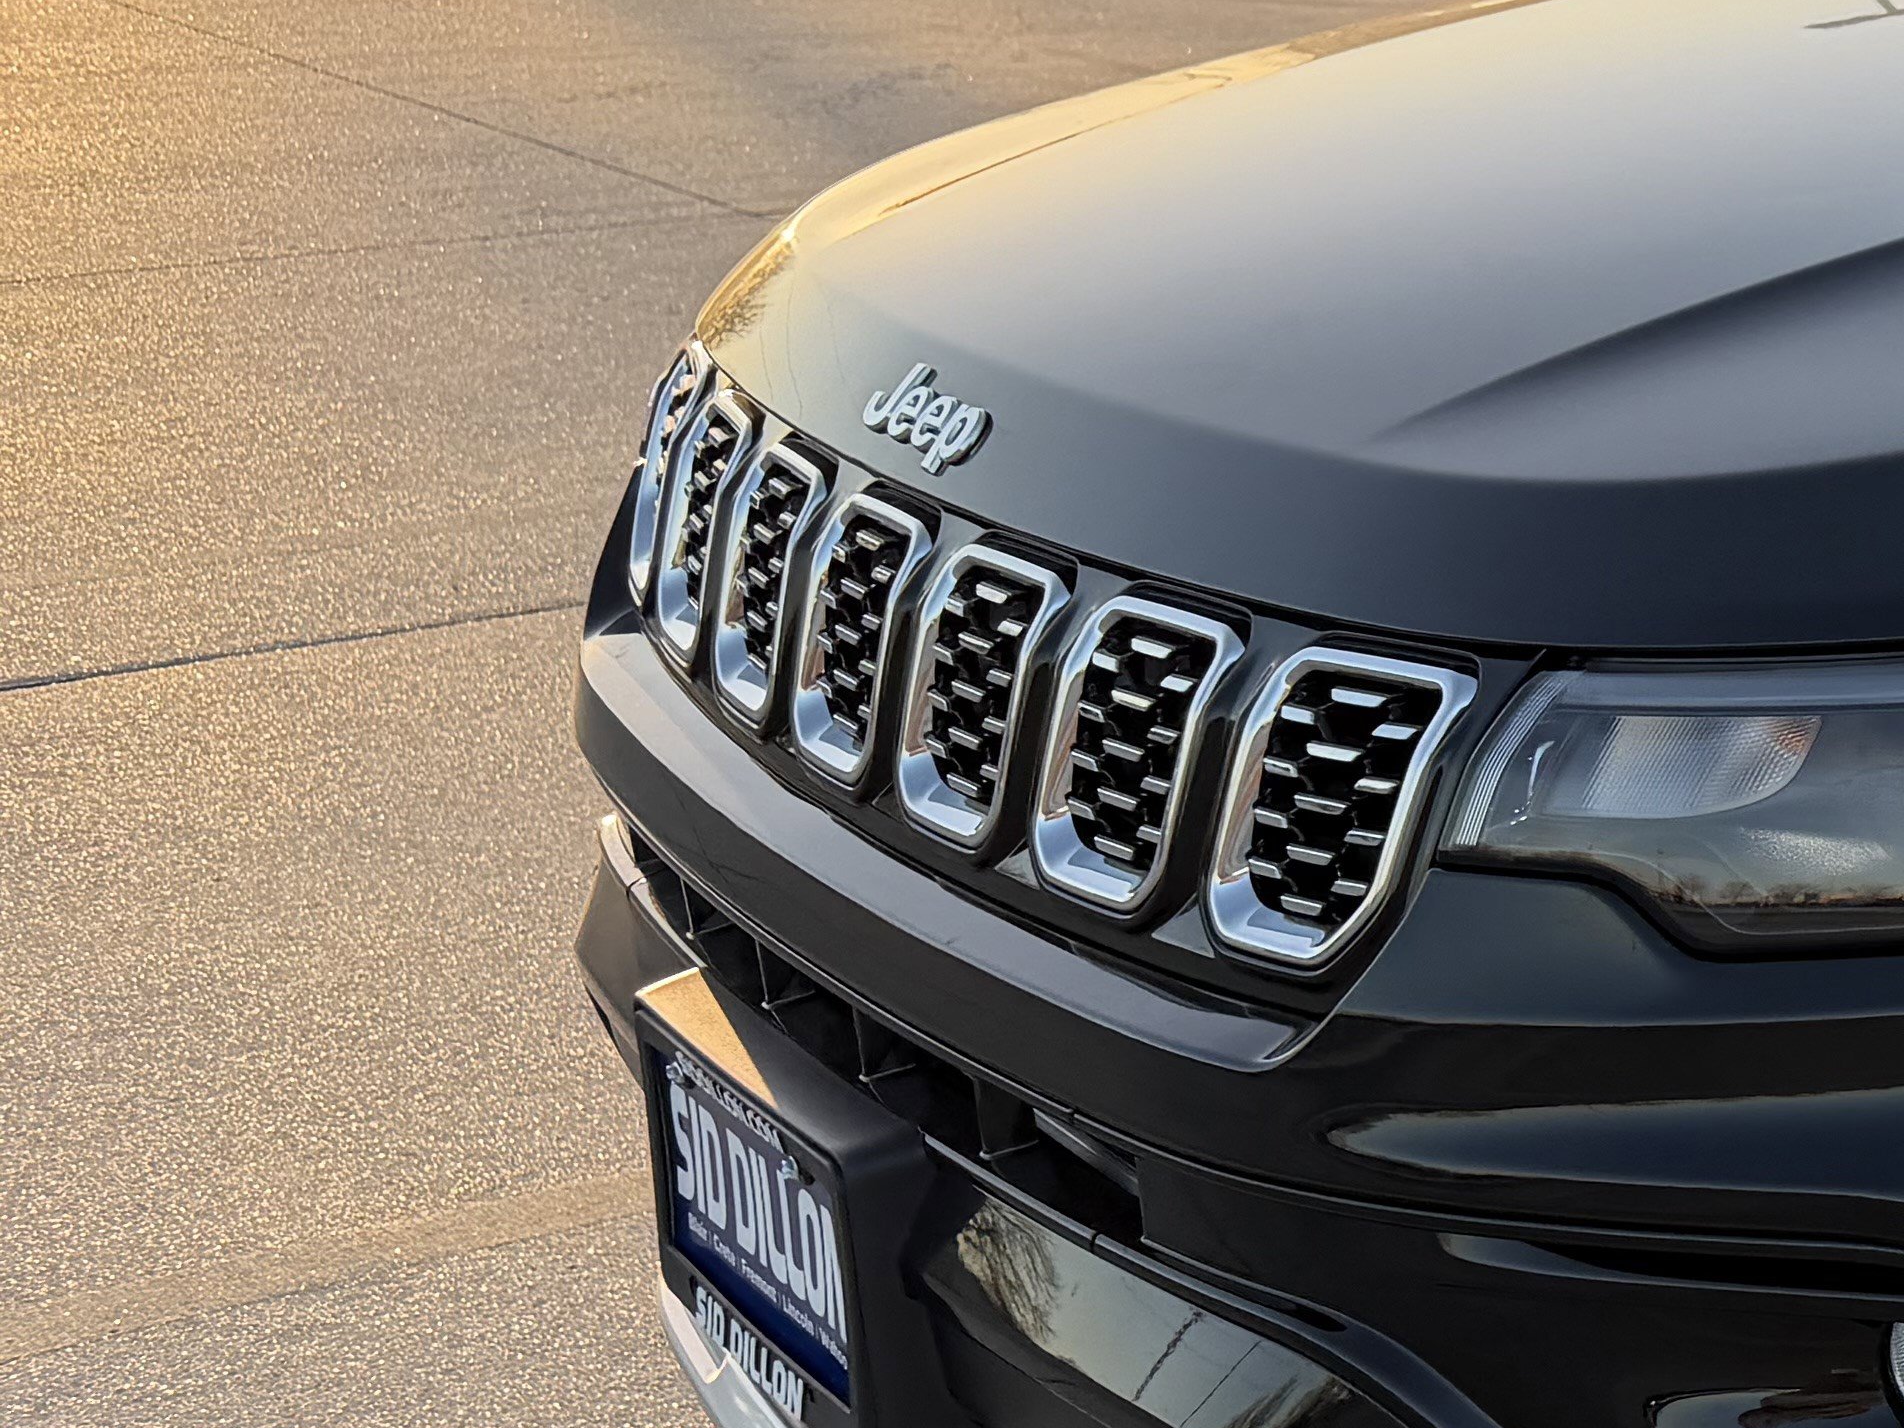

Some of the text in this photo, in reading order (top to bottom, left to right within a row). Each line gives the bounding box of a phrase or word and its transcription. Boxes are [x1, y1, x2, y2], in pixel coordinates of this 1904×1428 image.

[862, 362, 992, 476] Jeep
[669, 1081, 848, 1344] SID DILLON
[694, 1285, 804, 1420] SID DILLON
